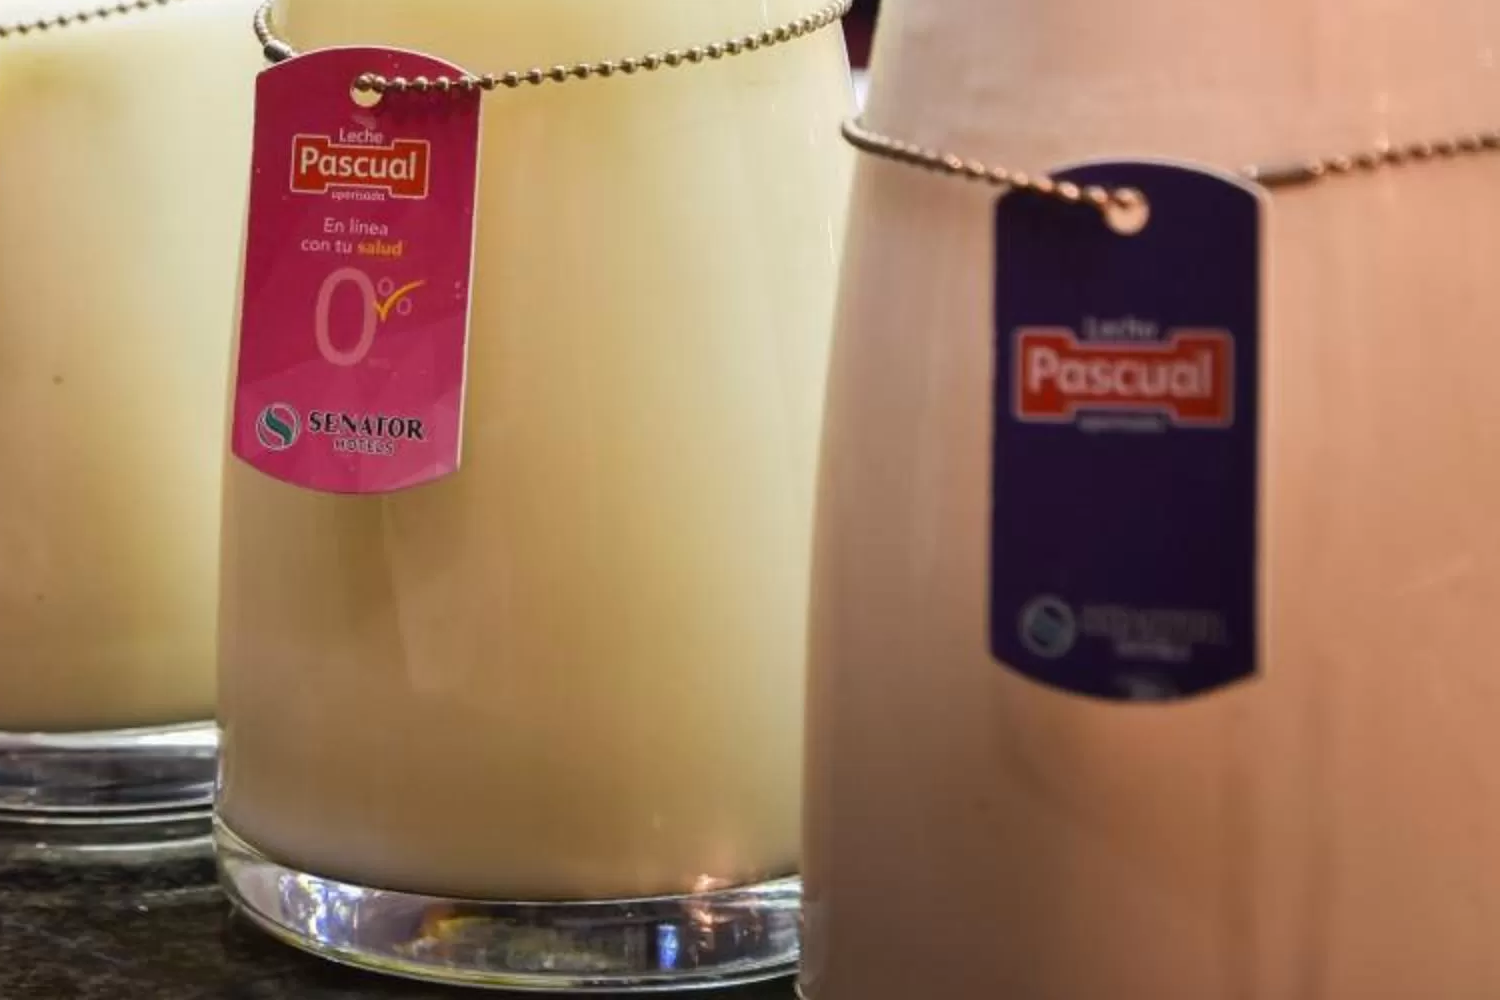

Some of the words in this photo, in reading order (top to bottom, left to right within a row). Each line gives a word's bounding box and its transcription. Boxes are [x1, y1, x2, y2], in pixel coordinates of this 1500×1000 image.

[339, 127, 384, 144] Leche
[300, 146, 417, 181] Pascual
[323, 217, 345, 234] En
[301, 239, 330, 252] con
[334, 240, 353, 254] tu
[357, 240, 404, 258] salud
[1028, 347, 1214, 399] Pascual
[308, 410, 426, 442] SENATOR
[333, 438, 395, 456] HOTELS
